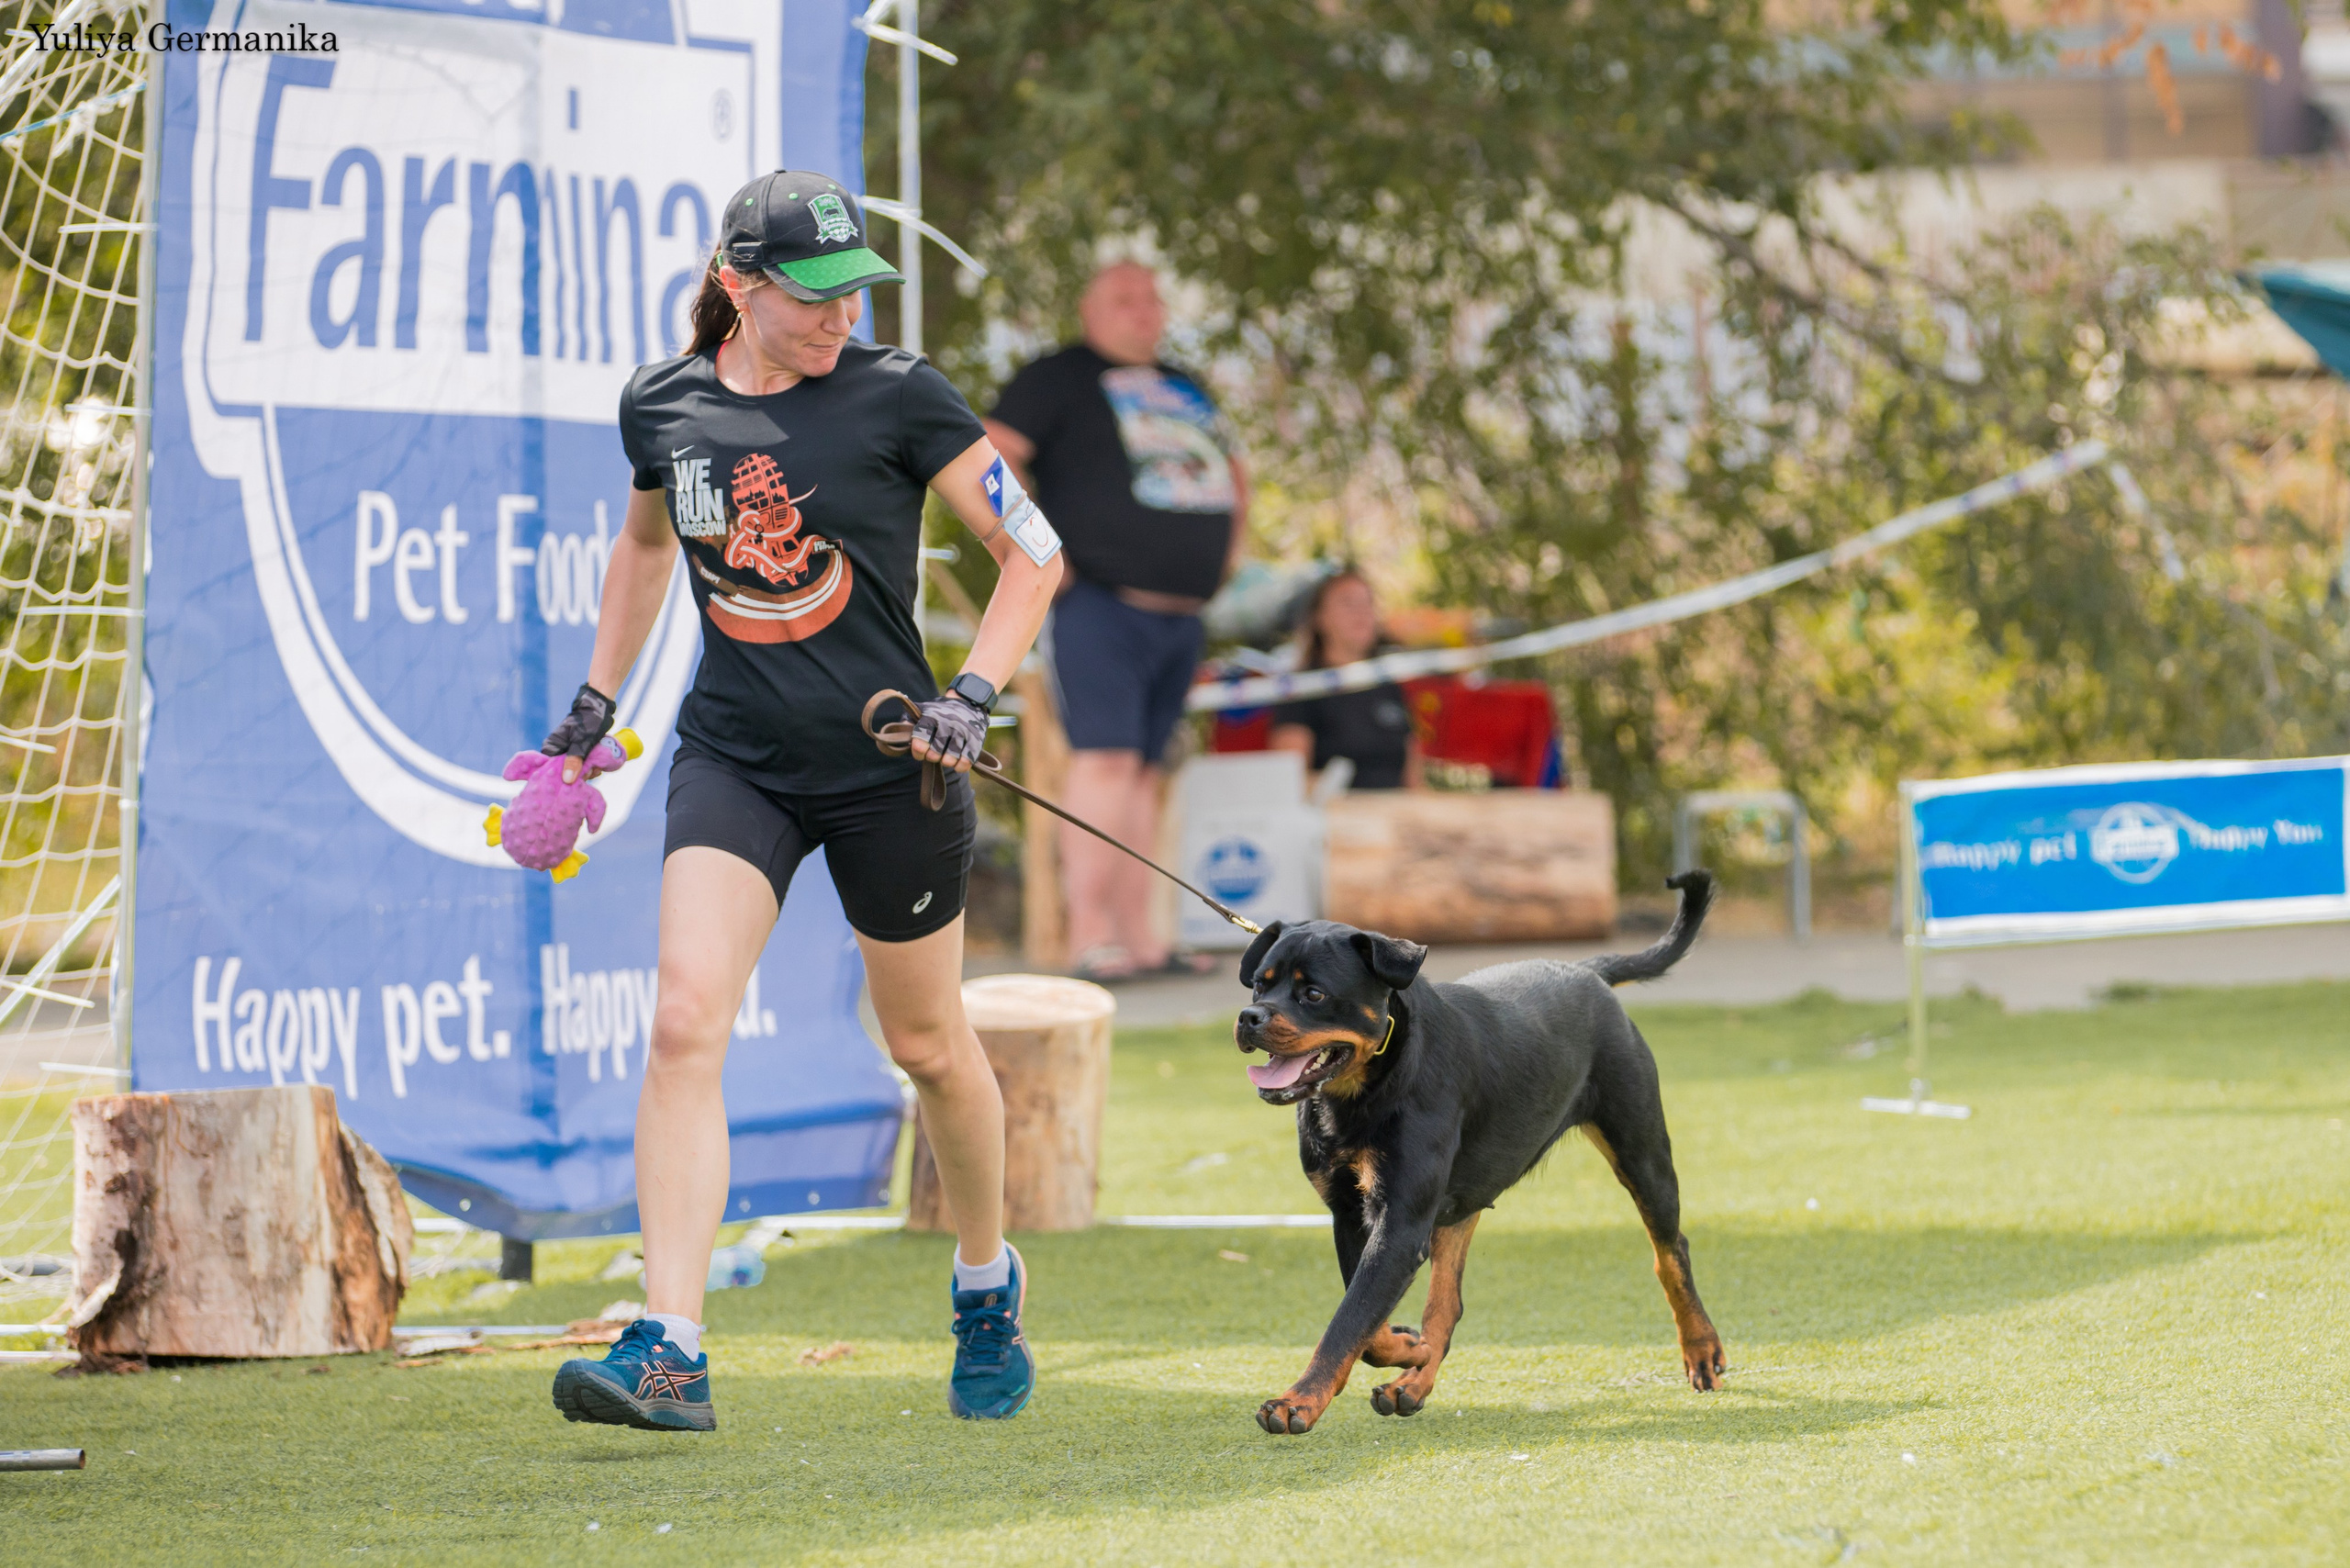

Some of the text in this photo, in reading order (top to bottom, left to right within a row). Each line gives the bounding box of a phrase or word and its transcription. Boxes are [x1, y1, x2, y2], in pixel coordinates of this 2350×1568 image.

[243, 53, 712, 365] Farmina
[673, 458, 711, 492] WE
[676, 488, 725, 522] RUN
[354, 490, 619, 628] Pet Food
[678, 520, 727, 537] MOSCOW
[192, 955, 361, 1101] Happy
[381, 953, 511, 1099] pet.
